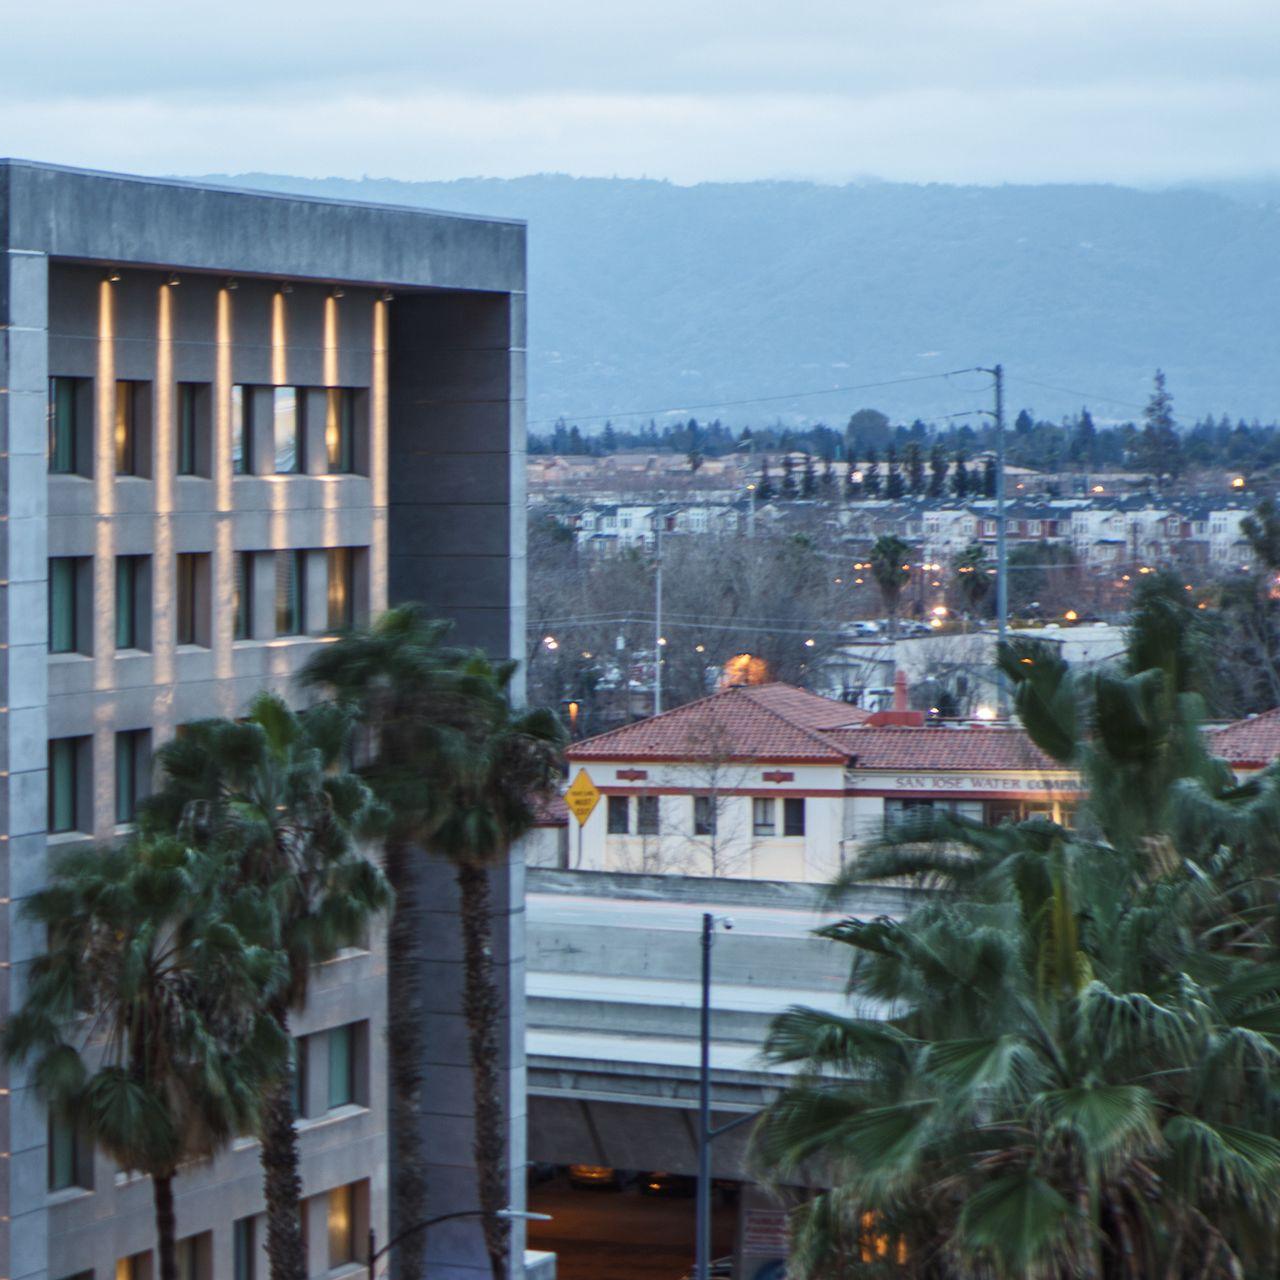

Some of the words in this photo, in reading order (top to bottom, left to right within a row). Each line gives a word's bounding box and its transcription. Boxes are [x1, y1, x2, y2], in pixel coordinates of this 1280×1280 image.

[896, 776, 925, 789] SAN
[932, 777, 964, 789] JOSE
[970, 778, 1022, 790] WATER
